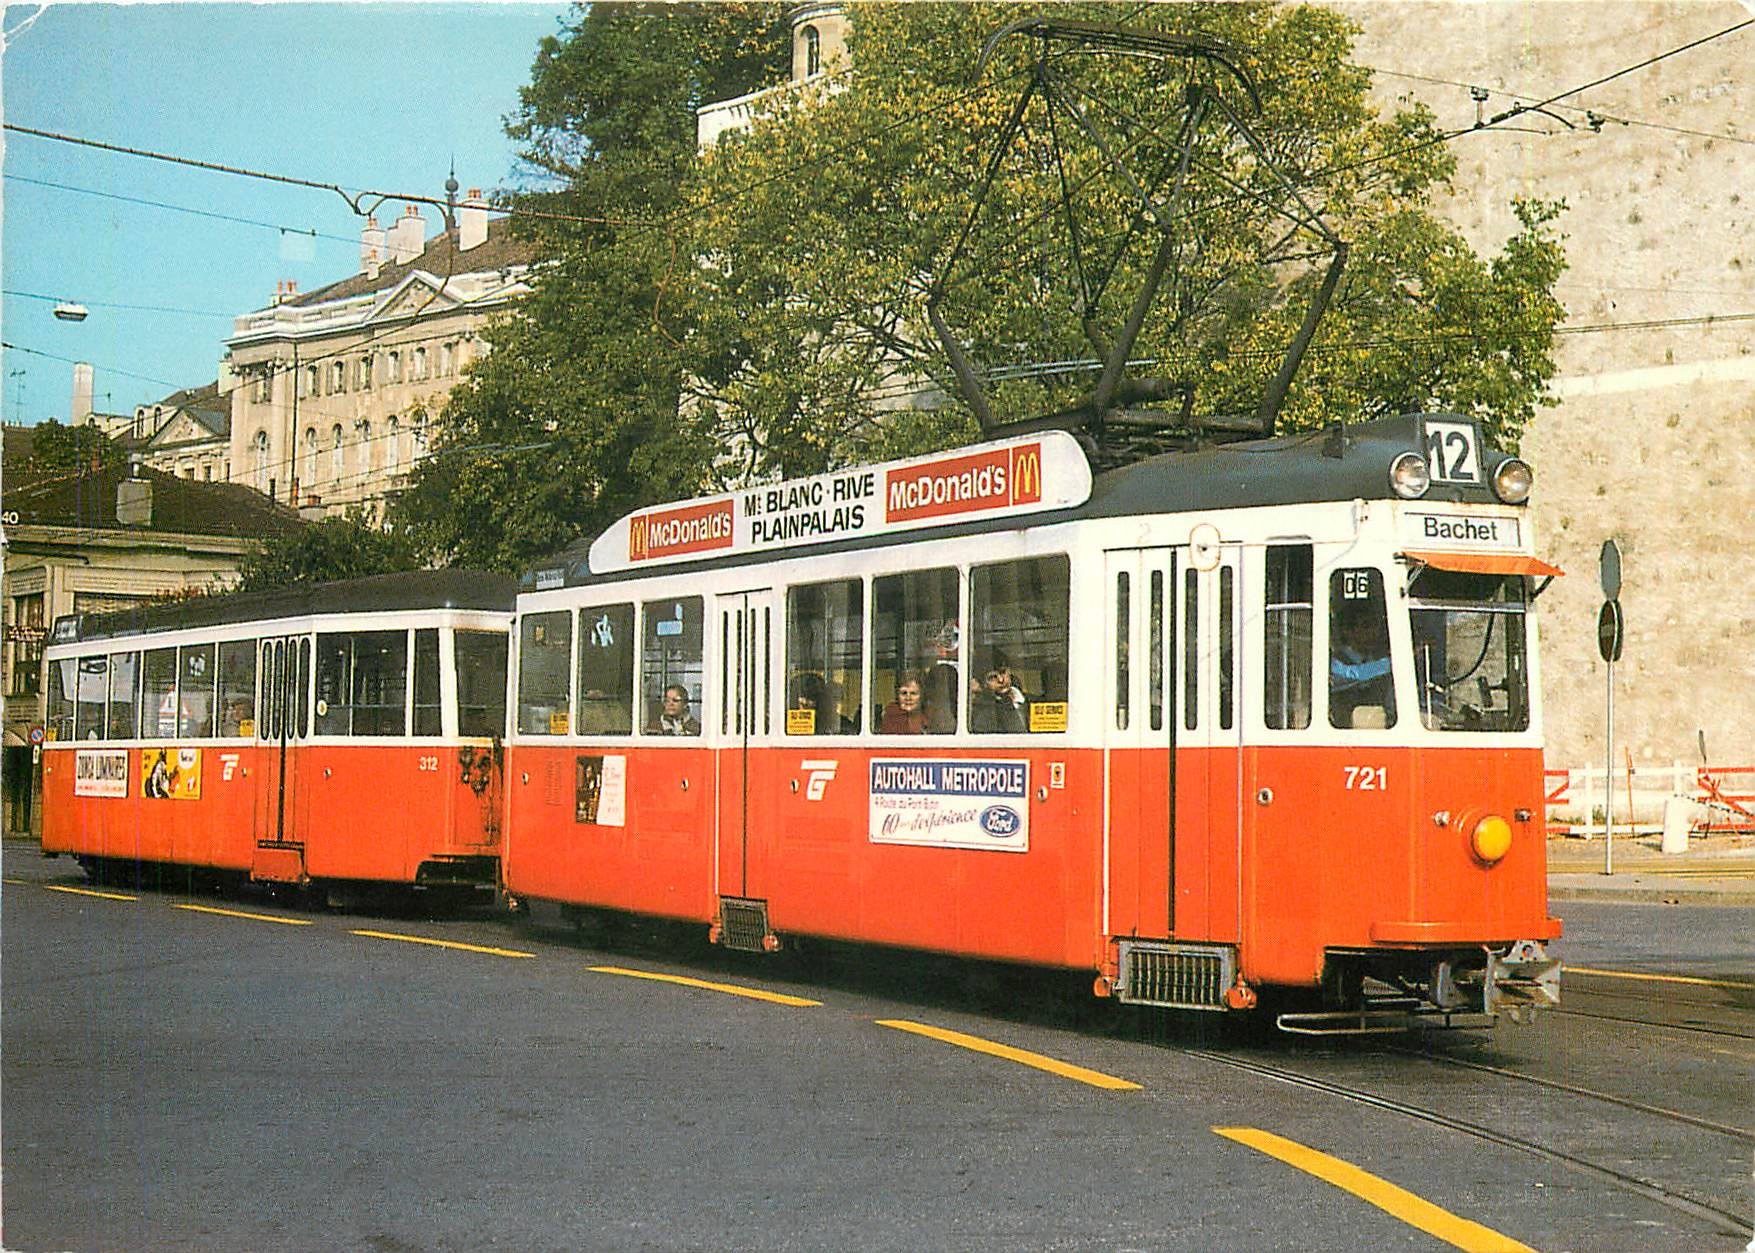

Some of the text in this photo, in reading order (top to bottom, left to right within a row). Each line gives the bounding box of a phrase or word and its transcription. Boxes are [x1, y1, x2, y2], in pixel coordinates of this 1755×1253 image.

[1427, 430, 1474, 480] 12
[767, 481, 823, 513] BLANC
[833, 473, 875, 501] RIVE
[889, 464, 1007, 512] McDonald's
[650, 510, 732, 548] McDonald's
[752, 505, 865, 544] PLAINPALAIS
[1424, 517, 1498, 541] Bachet
[419, 756, 439, 771] 312
[874, 766, 1023, 793] AUTOHALL METROPOLE
[1344, 766, 1387, 791] 721
[987, 809, 1013, 833] Ford
